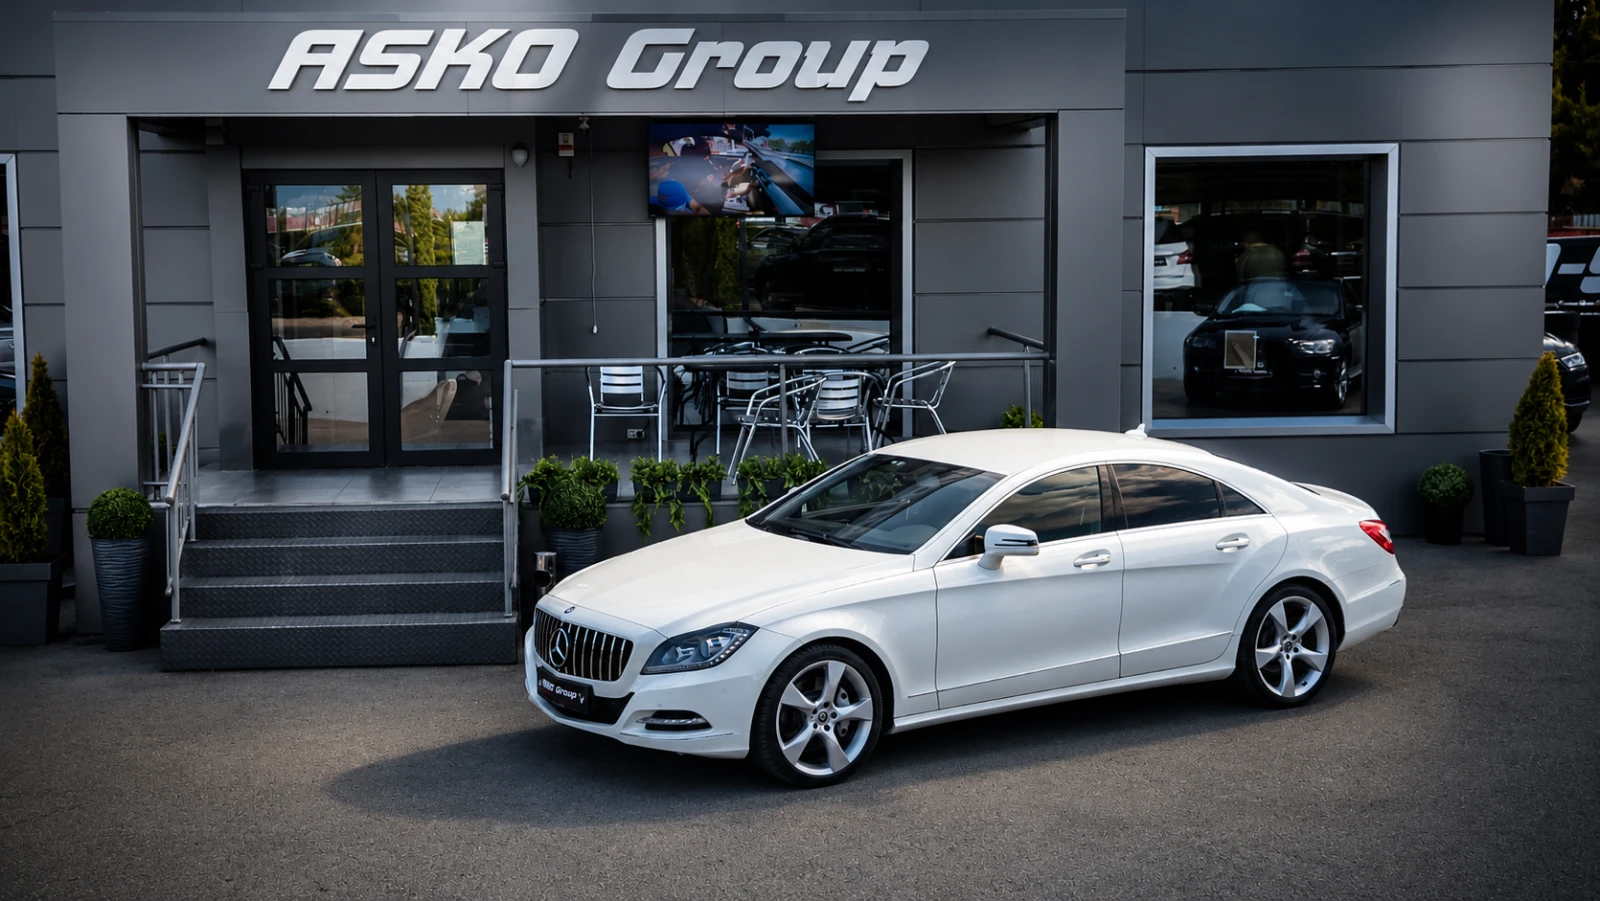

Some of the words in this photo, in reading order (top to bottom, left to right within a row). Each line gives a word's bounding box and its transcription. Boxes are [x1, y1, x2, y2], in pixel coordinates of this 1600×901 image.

[267, 28, 579, 90] ASKO
[606, 28, 930, 102] Group
[556, 686, 577, 700] Group
